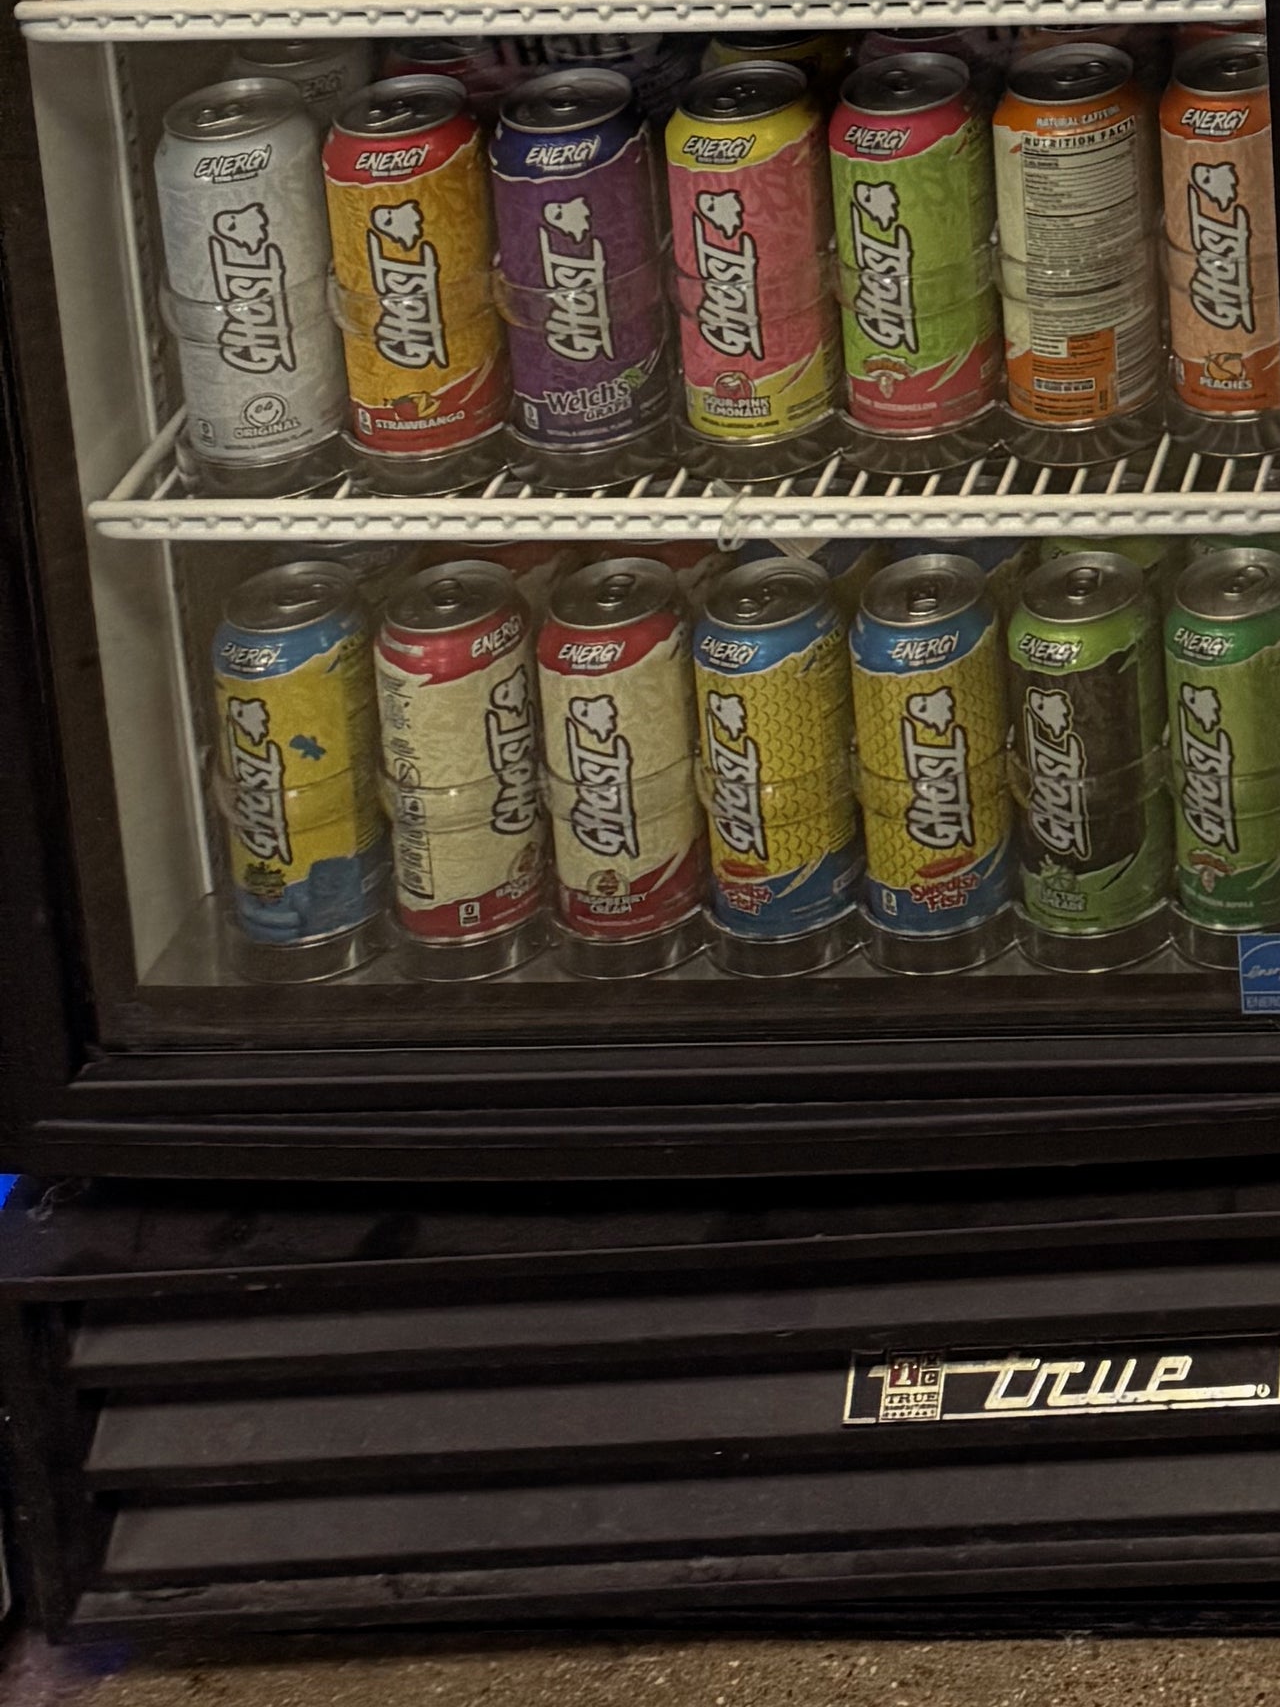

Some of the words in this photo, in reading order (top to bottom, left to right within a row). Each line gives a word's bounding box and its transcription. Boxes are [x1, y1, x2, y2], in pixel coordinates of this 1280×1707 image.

[1179, 108, 1251, 132] ENERGY
[525, 135, 600, 166] ENERGY
[681, 134, 756, 159] ENERGY
[843, 126, 912, 150] ENERGY
[1024, 135, 1097, 148] NUTRITION
[194, 145, 273, 182] ENERGY
[355, 143, 431, 172] ENERGY
[1187, 186, 1257, 334] GHOST
[538, 225, 616, 362] GHOST
[693, 209, 765, 361] GHOST
[850, 208, 920, 354] GHOST
[208, 234, 297, 375] GHOST
[367, 228, 450, 369] GHOST
[544, 379, 631, 416] Welch's
[1198, 375, 1254, 391] PEACHES
[234, 417, 301, 438] ORIGINAL
[375, 409, 466, 431] STRAWBANGO
[220, 640, 283, 667] ENERGY
[558, 640, 627, 666] ENERGY
[700, 635, 760, 666] ENERGY
[891, 632, 961, 663] ENERGY
[1017, 633, 1083, 663] ENERGY
[1173, 626, 1236, 656] ENERGY
[226, 715, 293, 866] GHOST
[566, 716, 640, 860] GHOST
[703, 709, 770, 860] GHOST
[905, 718, 977, 850] GHOST
[1025, 706, 1094, 862] GHOST
[1179, 701, 1241, 855] GHOST
[909, 871, 981, 905] Swedish
[925, 889, 969, 915] Fish
